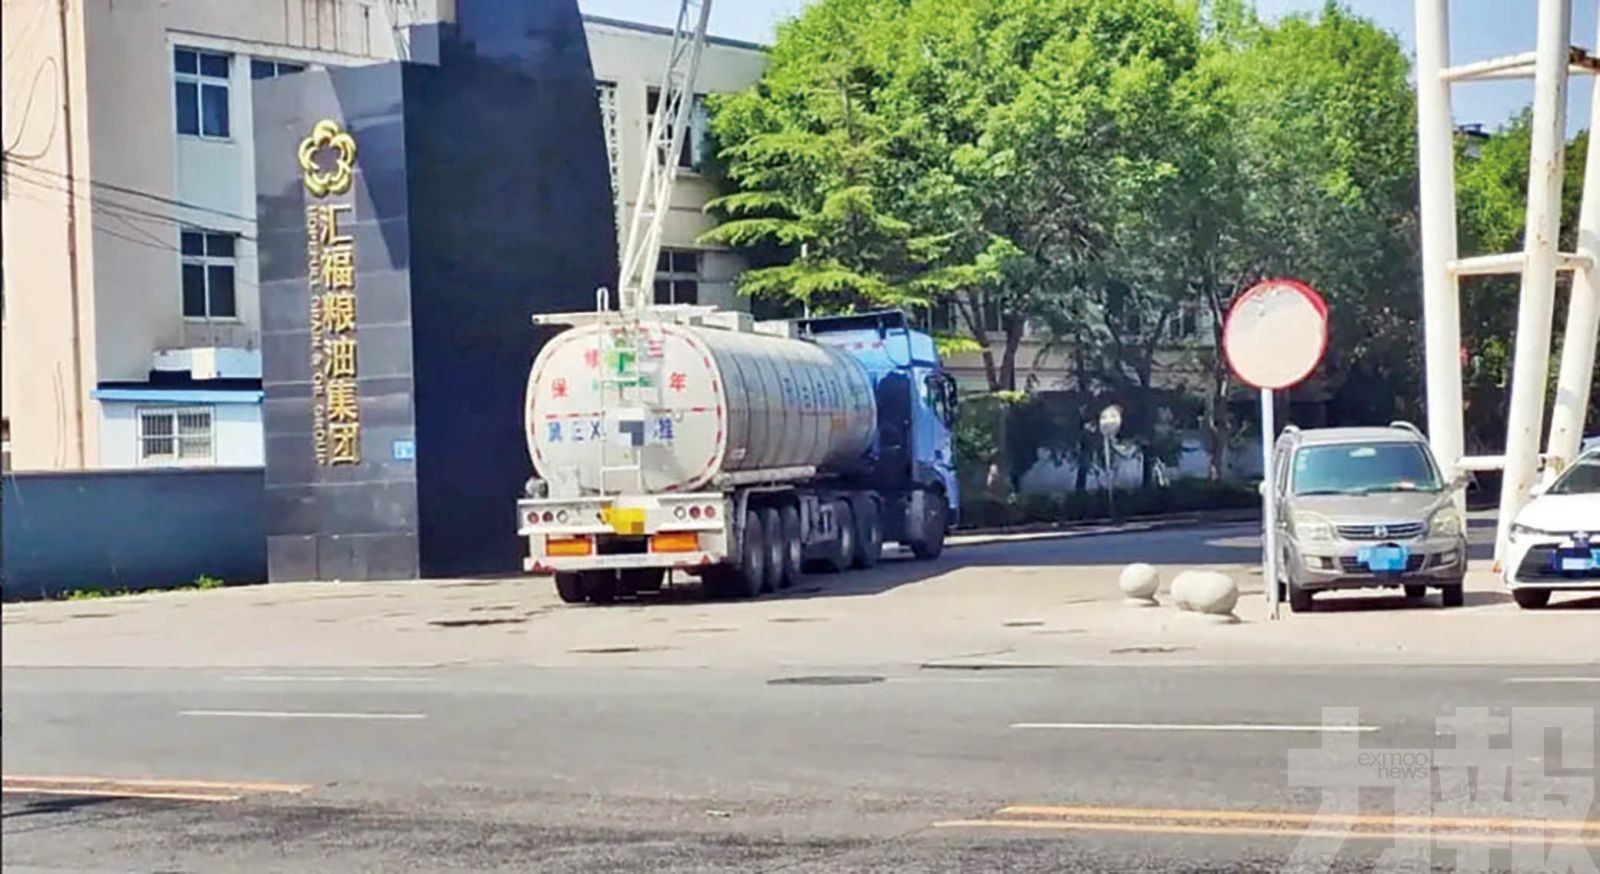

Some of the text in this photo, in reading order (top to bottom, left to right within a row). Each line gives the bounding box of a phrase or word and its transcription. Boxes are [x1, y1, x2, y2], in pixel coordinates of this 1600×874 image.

[320, 203, 361, 466] 汇福粮油集团
